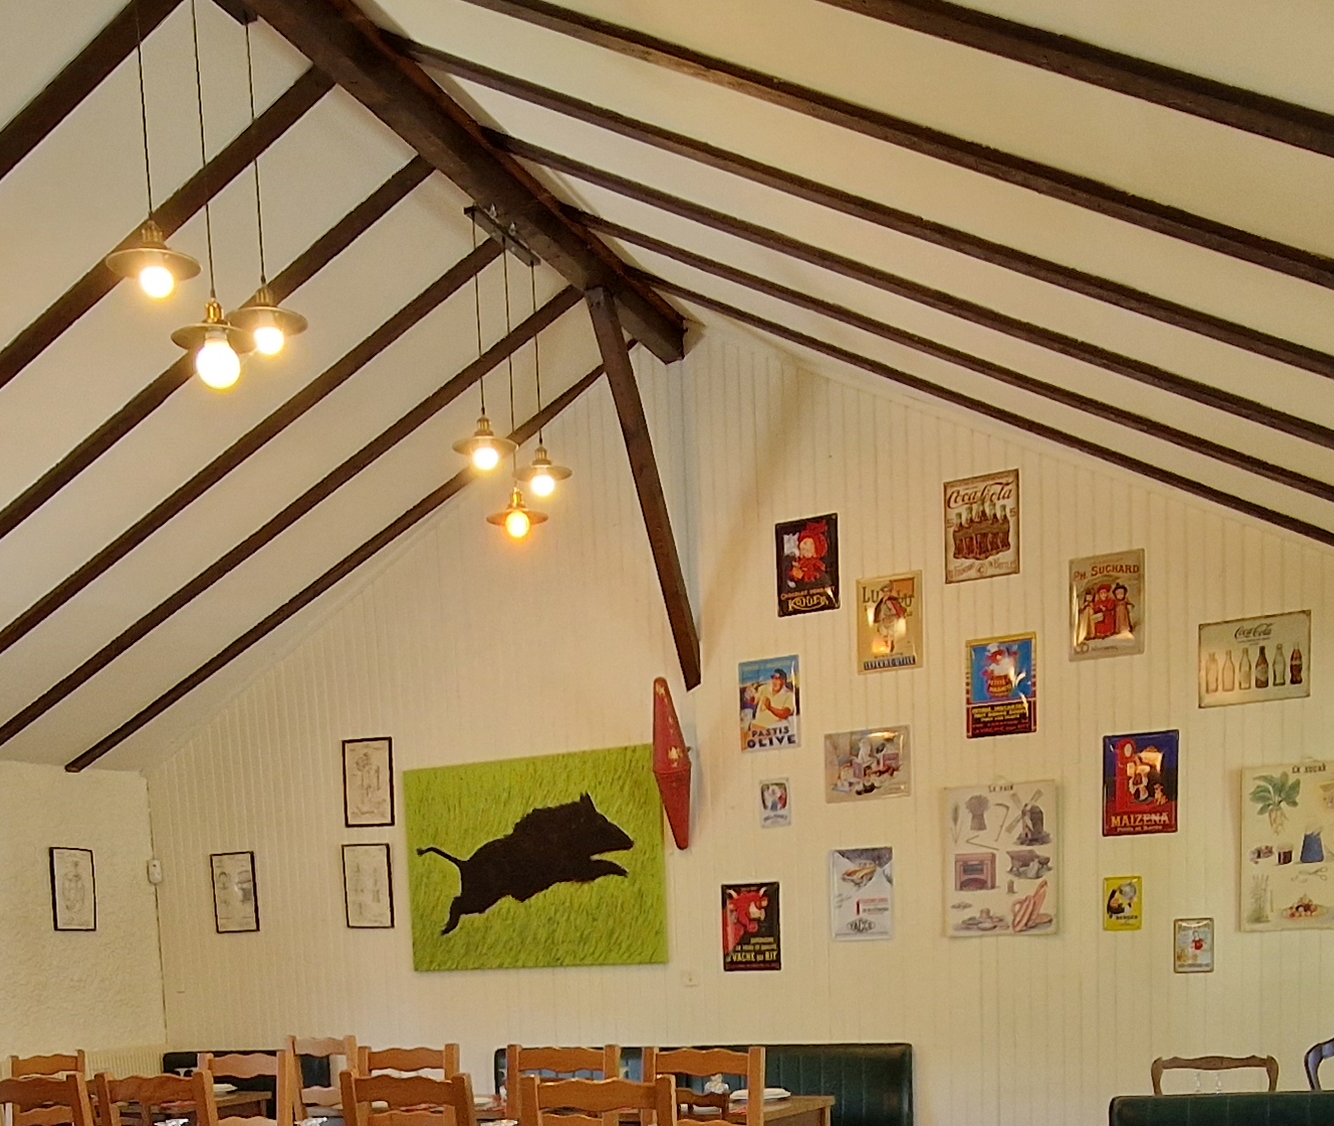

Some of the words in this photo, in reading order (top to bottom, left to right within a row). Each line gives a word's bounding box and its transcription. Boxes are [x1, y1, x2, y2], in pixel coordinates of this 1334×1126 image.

[1091, 564, 1140, 577] SUCHARD
[752, 726, 789, 738] PASTIS
[747, 734, 796, 749] OLIVE
[1111, 812, 1169, 828] MAIZENA
